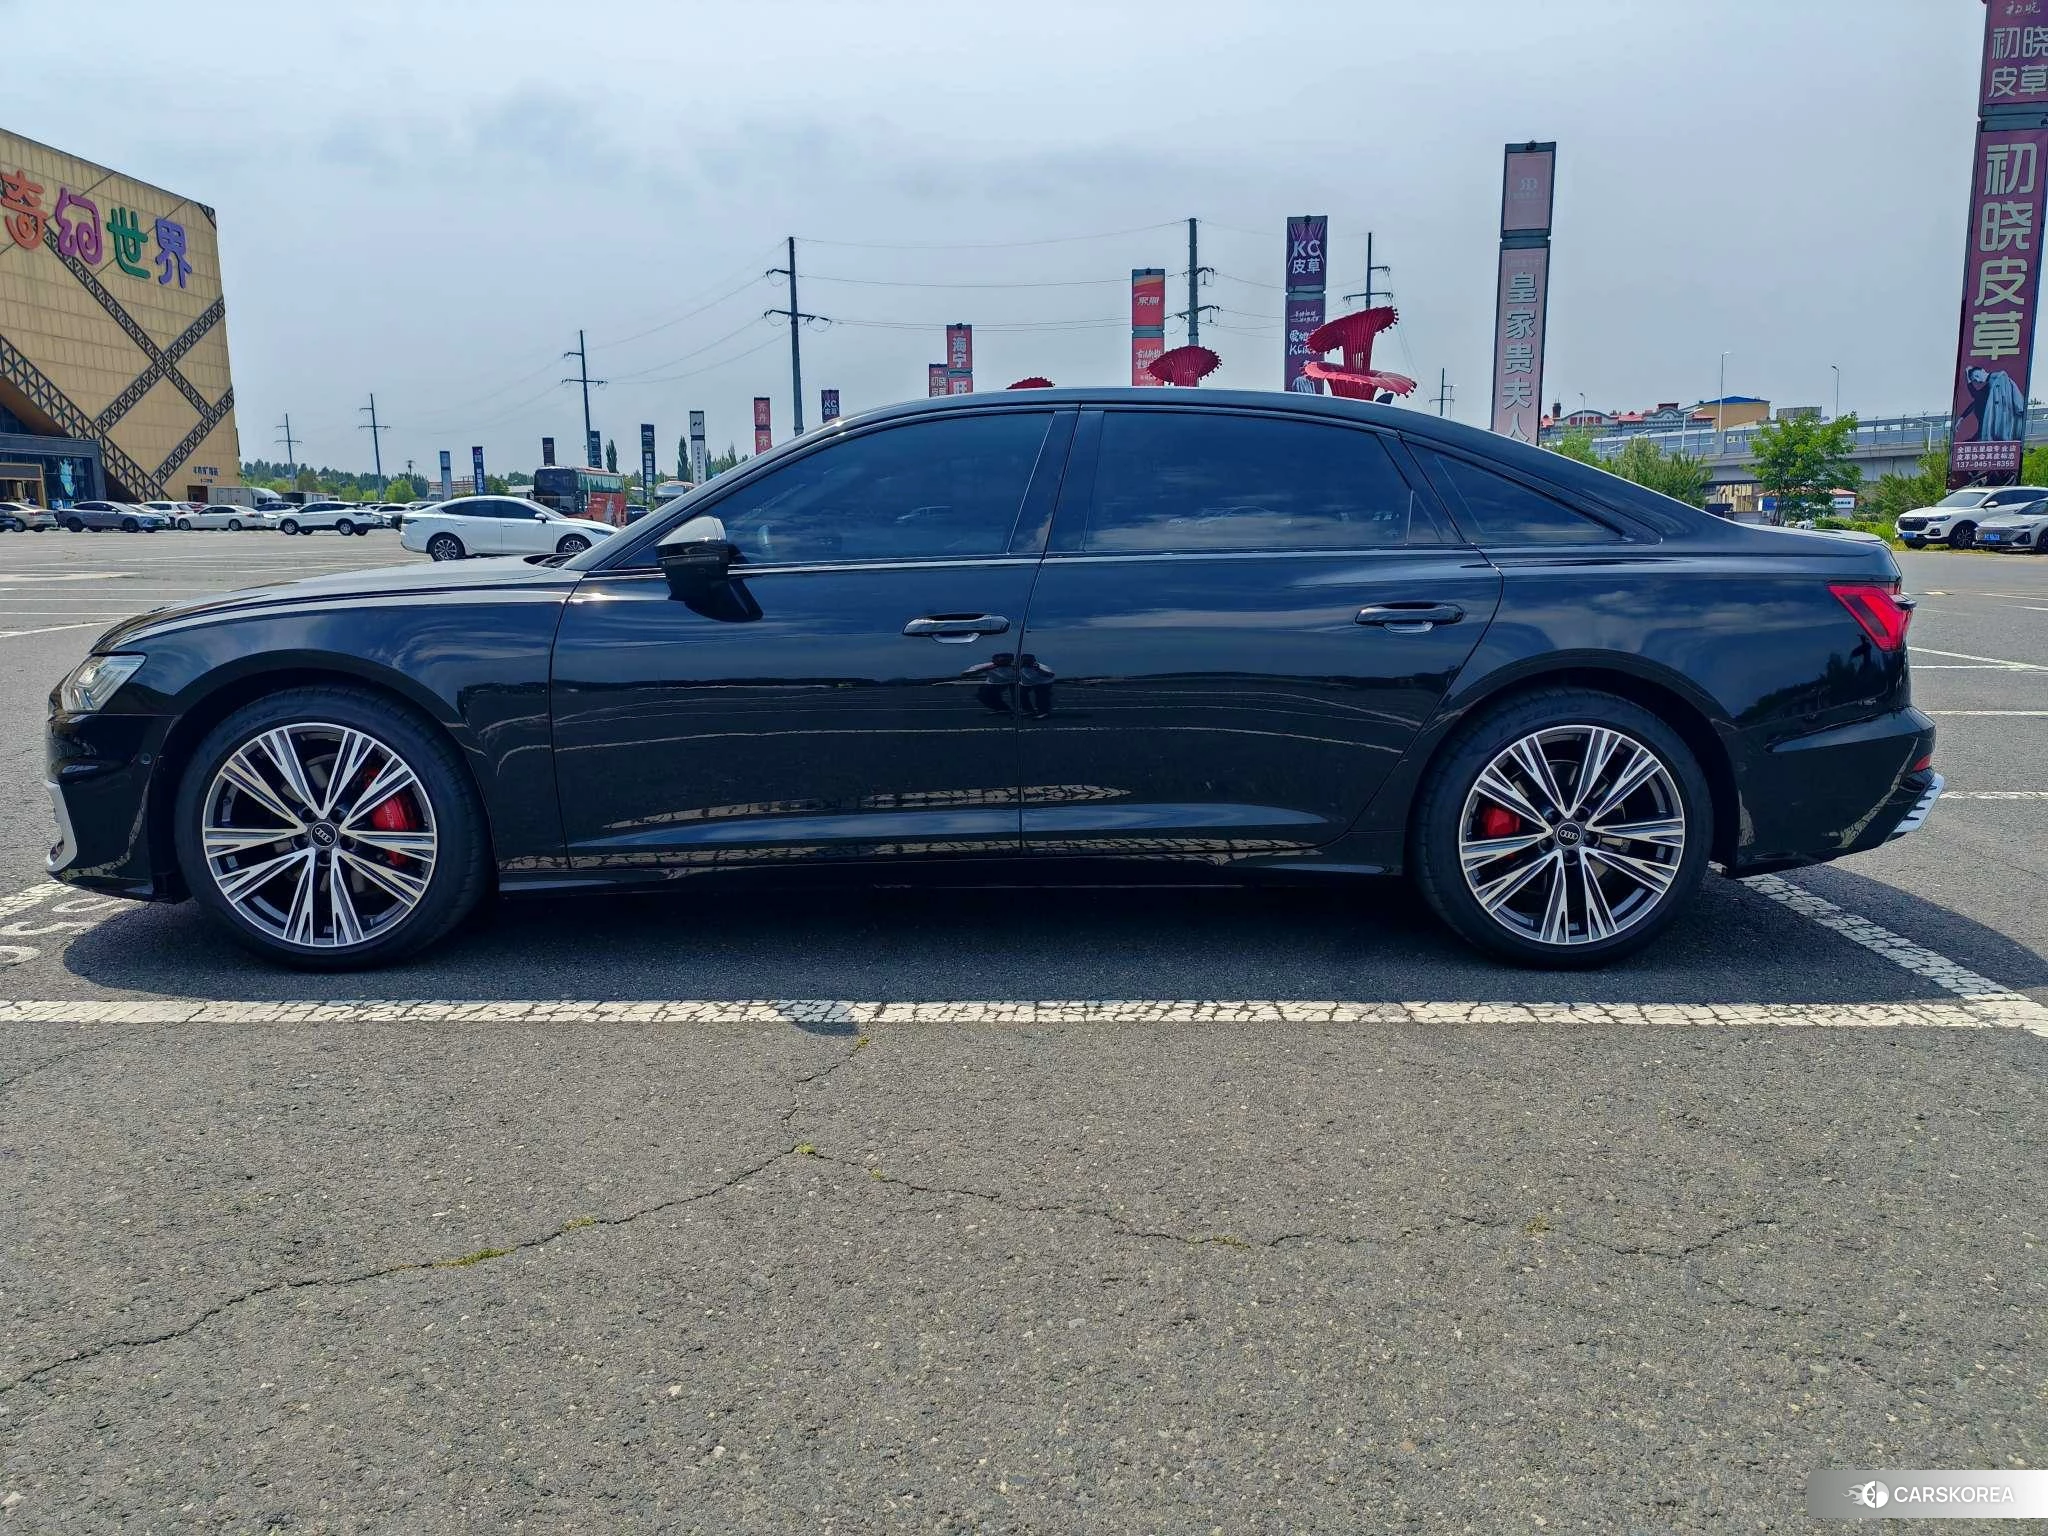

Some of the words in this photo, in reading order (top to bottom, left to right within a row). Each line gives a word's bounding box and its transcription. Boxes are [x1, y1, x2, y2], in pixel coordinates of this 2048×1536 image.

[1991, 26, 2048, 60] 初晓
[1988, 64, 2048, 97] 皮草
[0, 169, 193, 289] 奇幻世界
[1293, 240, 1321, 257] KC
[1970, 142, 2037, 361] 初晓皮草
[1292, 258, 1321, 274] 皮草
[1503, 271, 1538, 444] 皇家贵夫人
